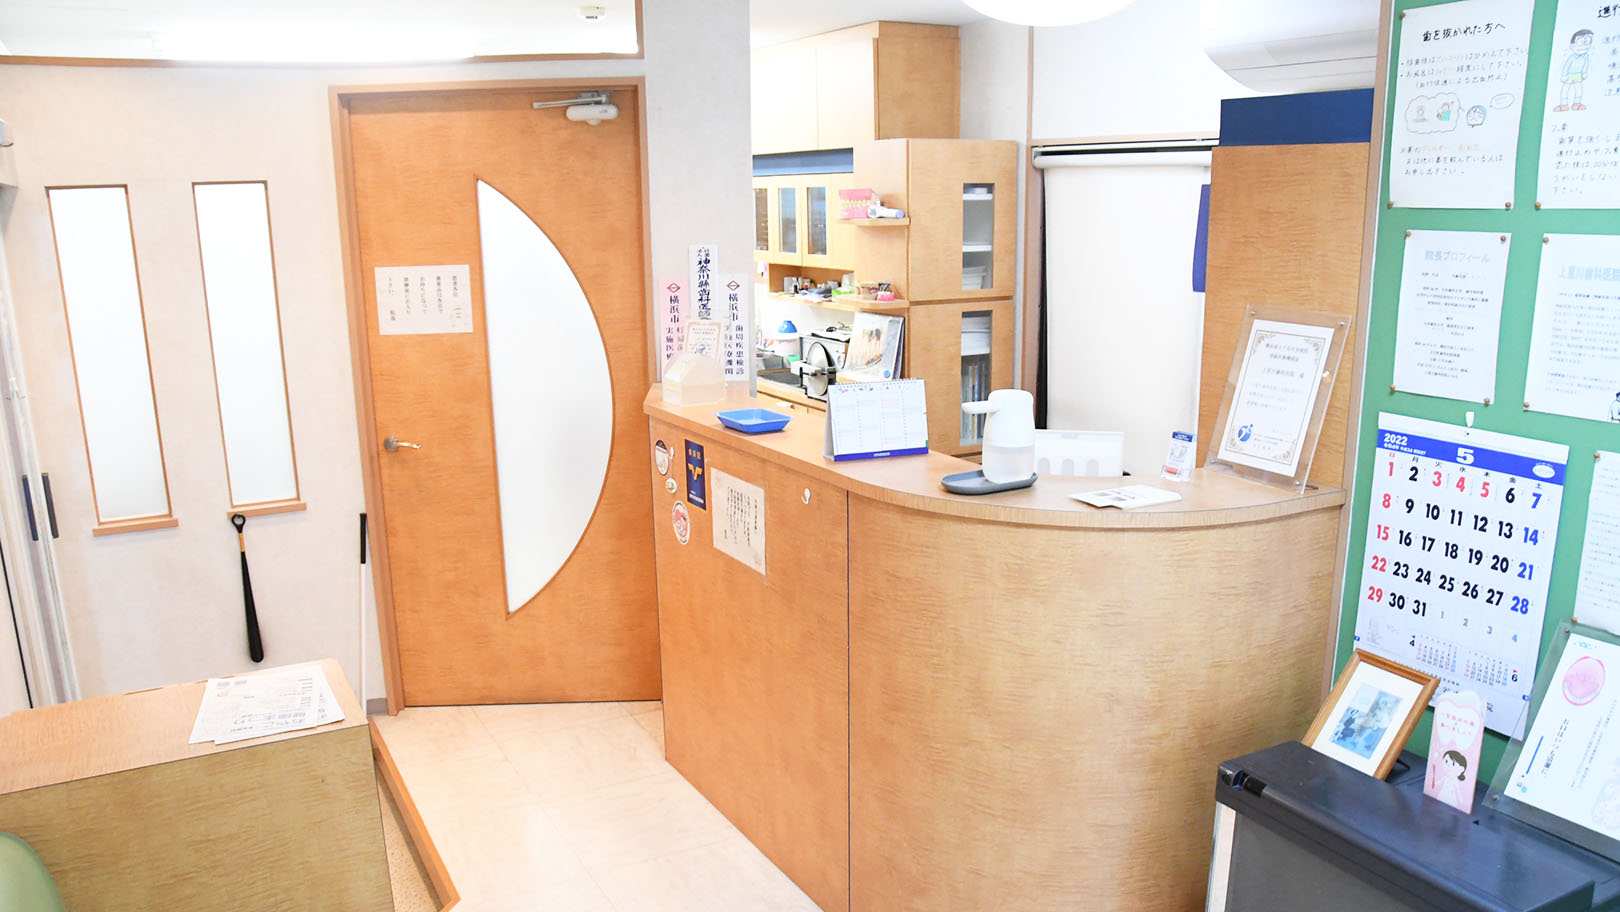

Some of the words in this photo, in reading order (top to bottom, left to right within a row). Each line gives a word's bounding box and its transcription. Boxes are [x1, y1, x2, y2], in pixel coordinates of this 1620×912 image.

[1423, 22, 1506, 42] 歯を抜かれた方へ
[669, 295, 680, 324] 横浜市
[729, 293, 739, 321] 横浜市
[1384, 433, 1408, 446] 2022
[1456, 447, 1475, 465] 5
[1389, 462, 1394, 476] 1
[1409, 466, 1418, 481] 2
[1433, 471, 1442, 486] 3
[1456, 477, 1465, 492] 4
[1481, 482, 1489, 497] 5
[1506, 488, 1515, 503] 6
[1532, 493, 1542, 509] 7
[1382, 494, 1391, 508] 8
[1406, 499, 1414, 513] 9
[1426, 503, 1440, 520] 10
[1451, 509, 1462, 526] 11
[1474, 515, 1488, 532] 12
[1499, 521, 1513, 538] 13
[1524, 527, 1538, 545] 14
[1377, 524, 1389, 540] 15
[1399, 530, 1412, 546] 16
[1422, 536, 1435, 552] 17
[1445, 542, 1458, 559] 18
[1469, 548, 1483, 565] 19
[1491, 555, 1509, 573] 20
[1517, 562, 1533, 580] 21
[1371, 555, 1386, 572] 22
[1393, 562, 1409, 578] 23
[1416, 568, 1431, 585] 24
[1439, 575, 1454, 592] 25
[1462, 581, 1478, 599] 26
[1486, 589, 1503, 606] 27
[1511, 596, 1529, 614] 28
[1368, 586, 1383, 602] 29
[1389, 593, 1405, 609] 30
[1413, 600, 1426, 616] 31
[1441, 611, 1444, 619] 1
[1463, 618, 1468, 626] 2
[1487, 626, 1492, 634] 3
[1409, 639, 1415, 647] 4
[1512, 674, 1517, 682] 6
